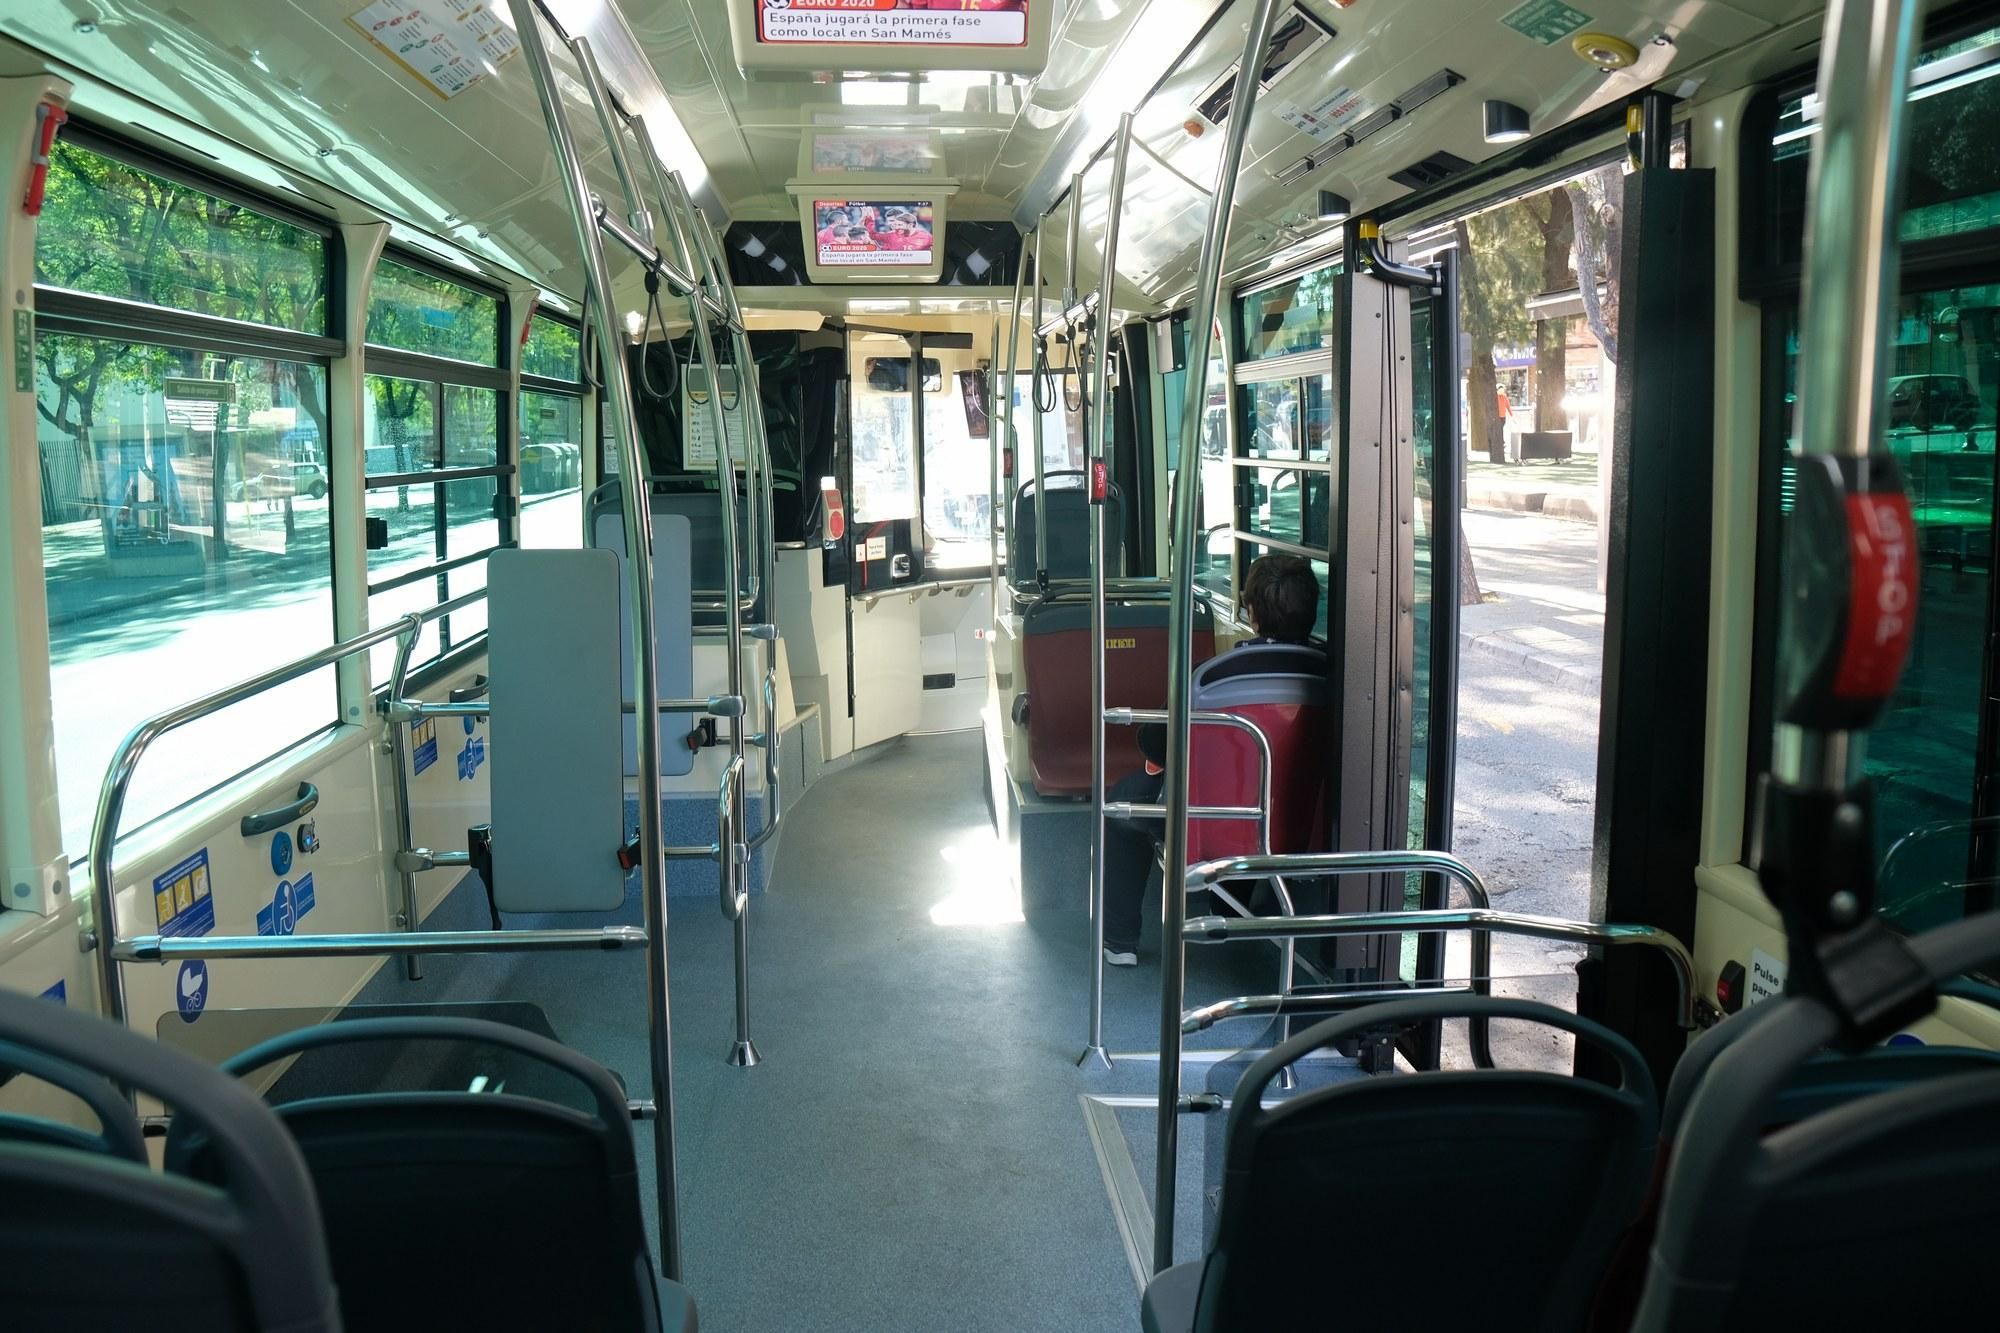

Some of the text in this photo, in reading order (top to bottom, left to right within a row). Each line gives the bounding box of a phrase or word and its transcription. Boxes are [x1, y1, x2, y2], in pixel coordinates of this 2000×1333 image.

[769, 11, 982, 27] España jugará la primera fase
[769, 27, 952, 39] como local en San Mamés
[1873, 505, 1909, 647] STOP
[1754, 962, 1780, 987] Pulse
